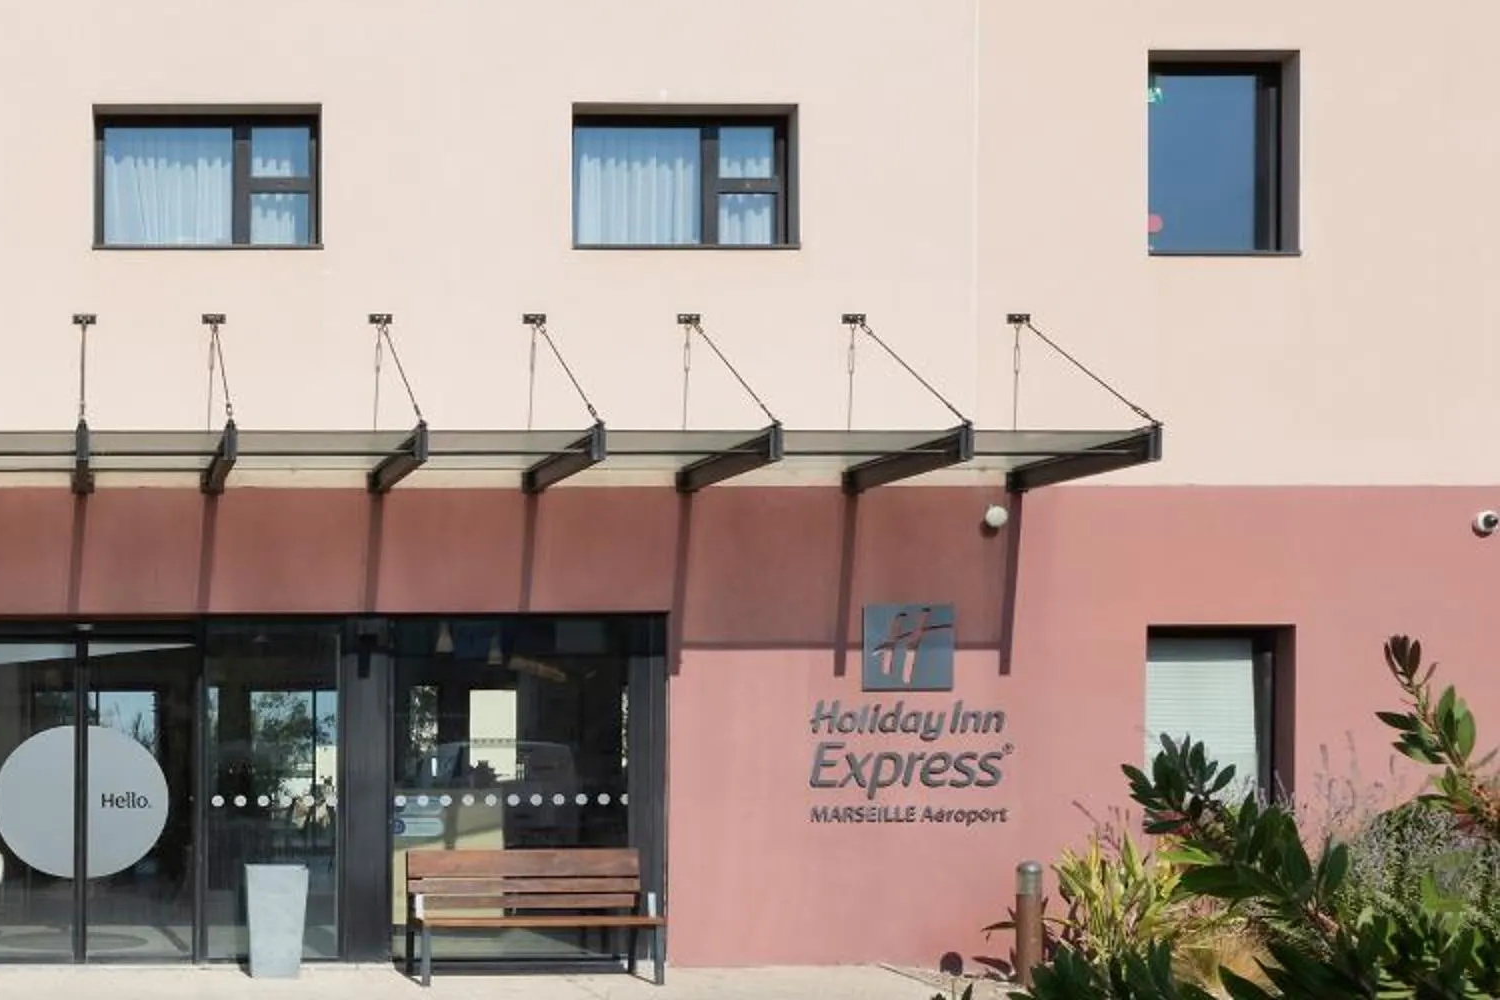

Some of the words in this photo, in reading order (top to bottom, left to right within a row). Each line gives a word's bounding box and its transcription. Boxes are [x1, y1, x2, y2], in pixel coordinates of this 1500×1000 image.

[809, 700, 946, 741] Holiday
[949, 700, 1006, 734] Inn
[810, 806, 916, 823] MARSEILLE
